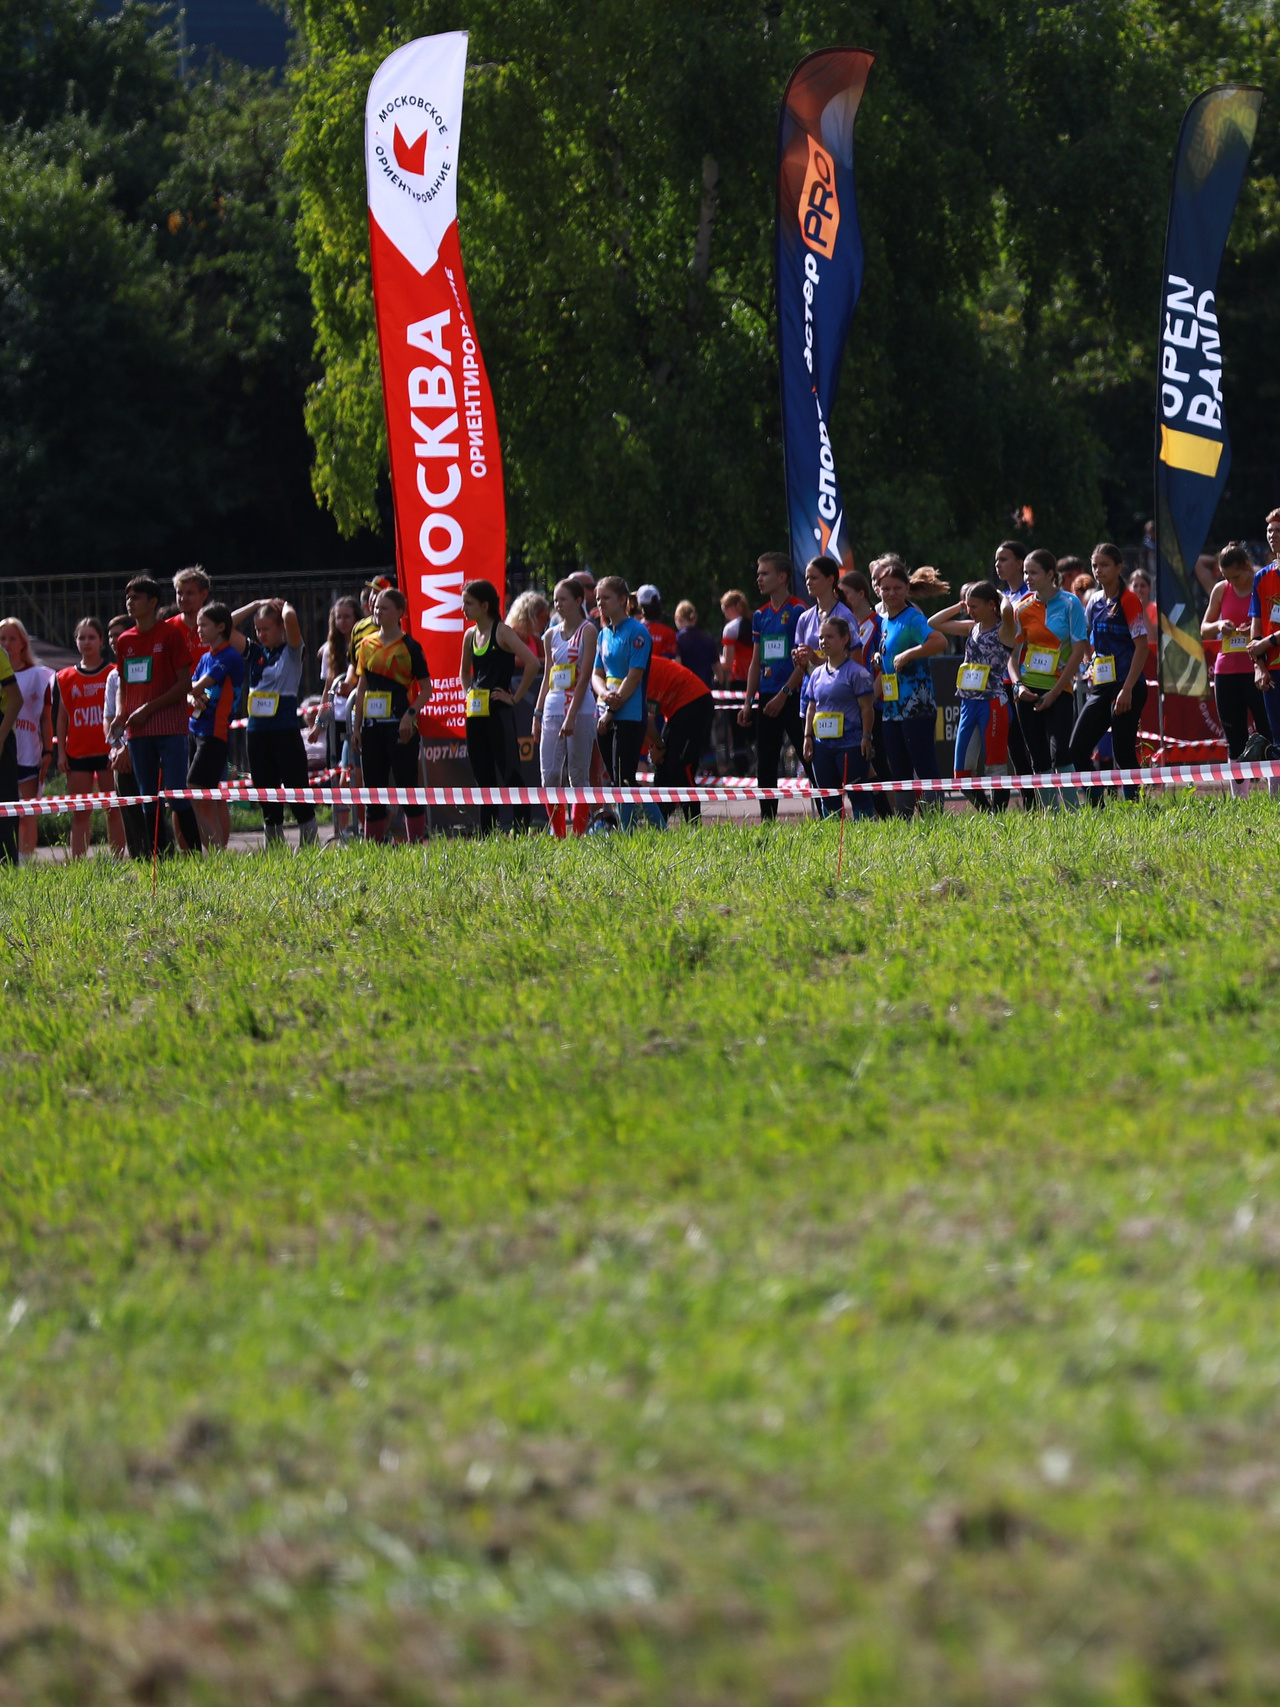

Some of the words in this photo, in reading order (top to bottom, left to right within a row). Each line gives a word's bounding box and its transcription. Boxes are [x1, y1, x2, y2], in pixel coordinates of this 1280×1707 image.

[378, 95, 448, 135] МОСКОВСКОЕ
[804, 150, 833, 248] PRO
[1162, 274, 1199, 419] OPEN
[1186, 289, 1223, 430] BAND
[406, 308, 464, 632] МОСКВА
